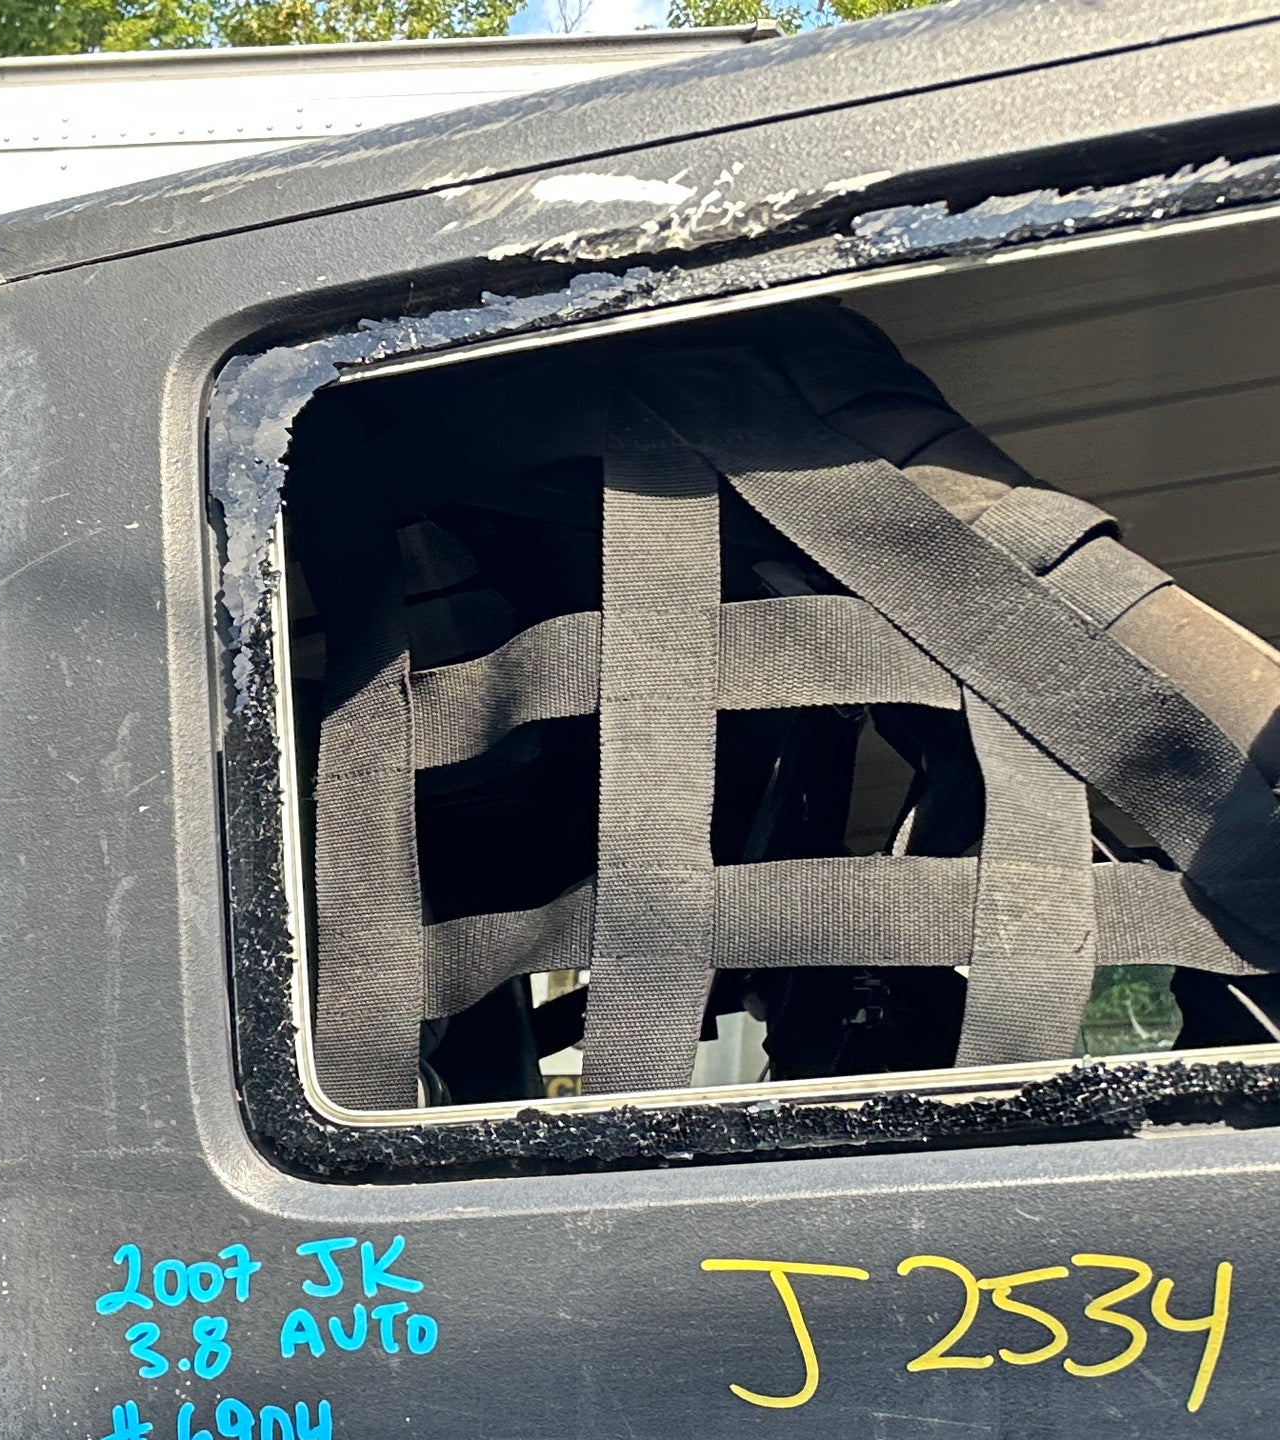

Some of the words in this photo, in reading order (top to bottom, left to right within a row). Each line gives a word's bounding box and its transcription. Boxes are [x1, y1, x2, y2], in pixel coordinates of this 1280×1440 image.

[95, 1243, 261, 1315] 2007
[296, 1235, 424, 1298] JK
[125, 1315, 232, 1379] 3.8
[280, 1302, 438, 1358] AUTO
[701, 1253, 1233, 1412] J2534
